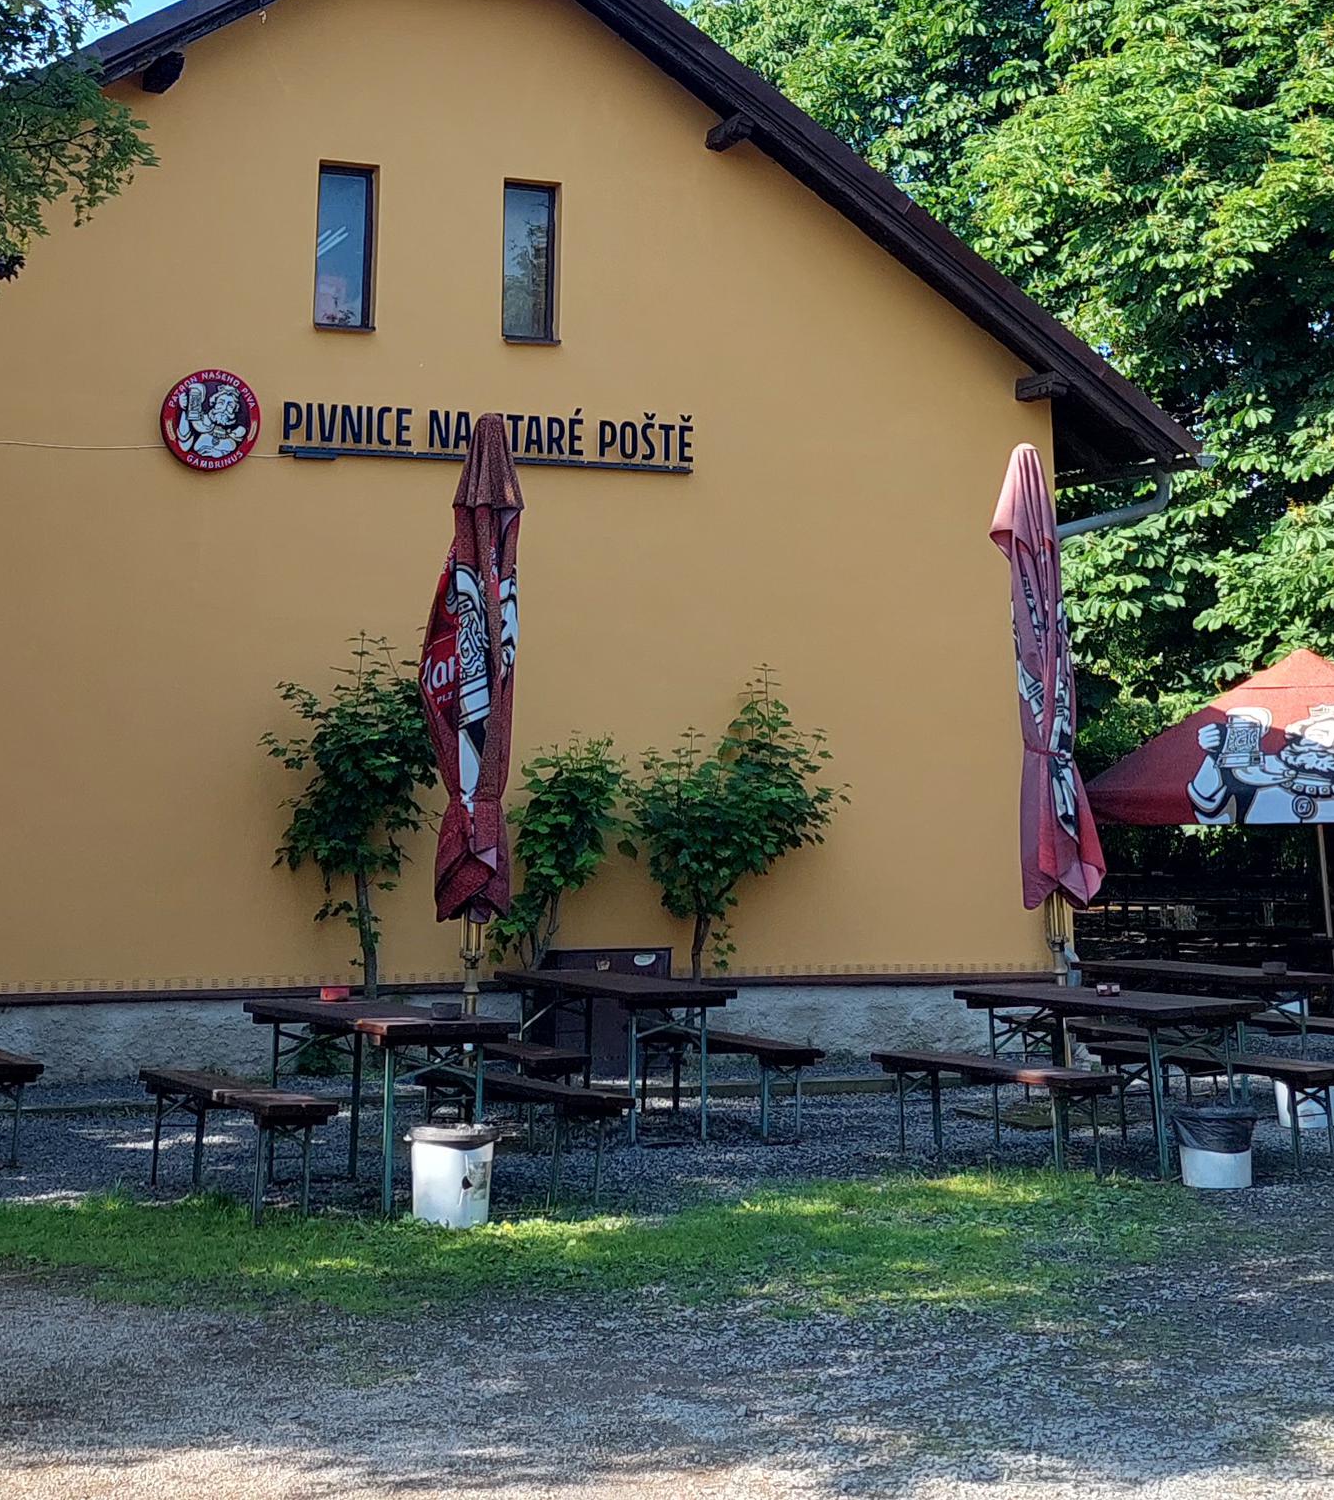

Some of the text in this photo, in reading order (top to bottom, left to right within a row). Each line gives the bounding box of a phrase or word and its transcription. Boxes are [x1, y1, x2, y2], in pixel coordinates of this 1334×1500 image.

[168, 370, 256, 409] PATRON NAŠEHO PIVA
[282, 401, 694, 462] PIVNICE NA TARÉ POŠTĚ
[186, 450, 244, 469] GAMBRINUS
